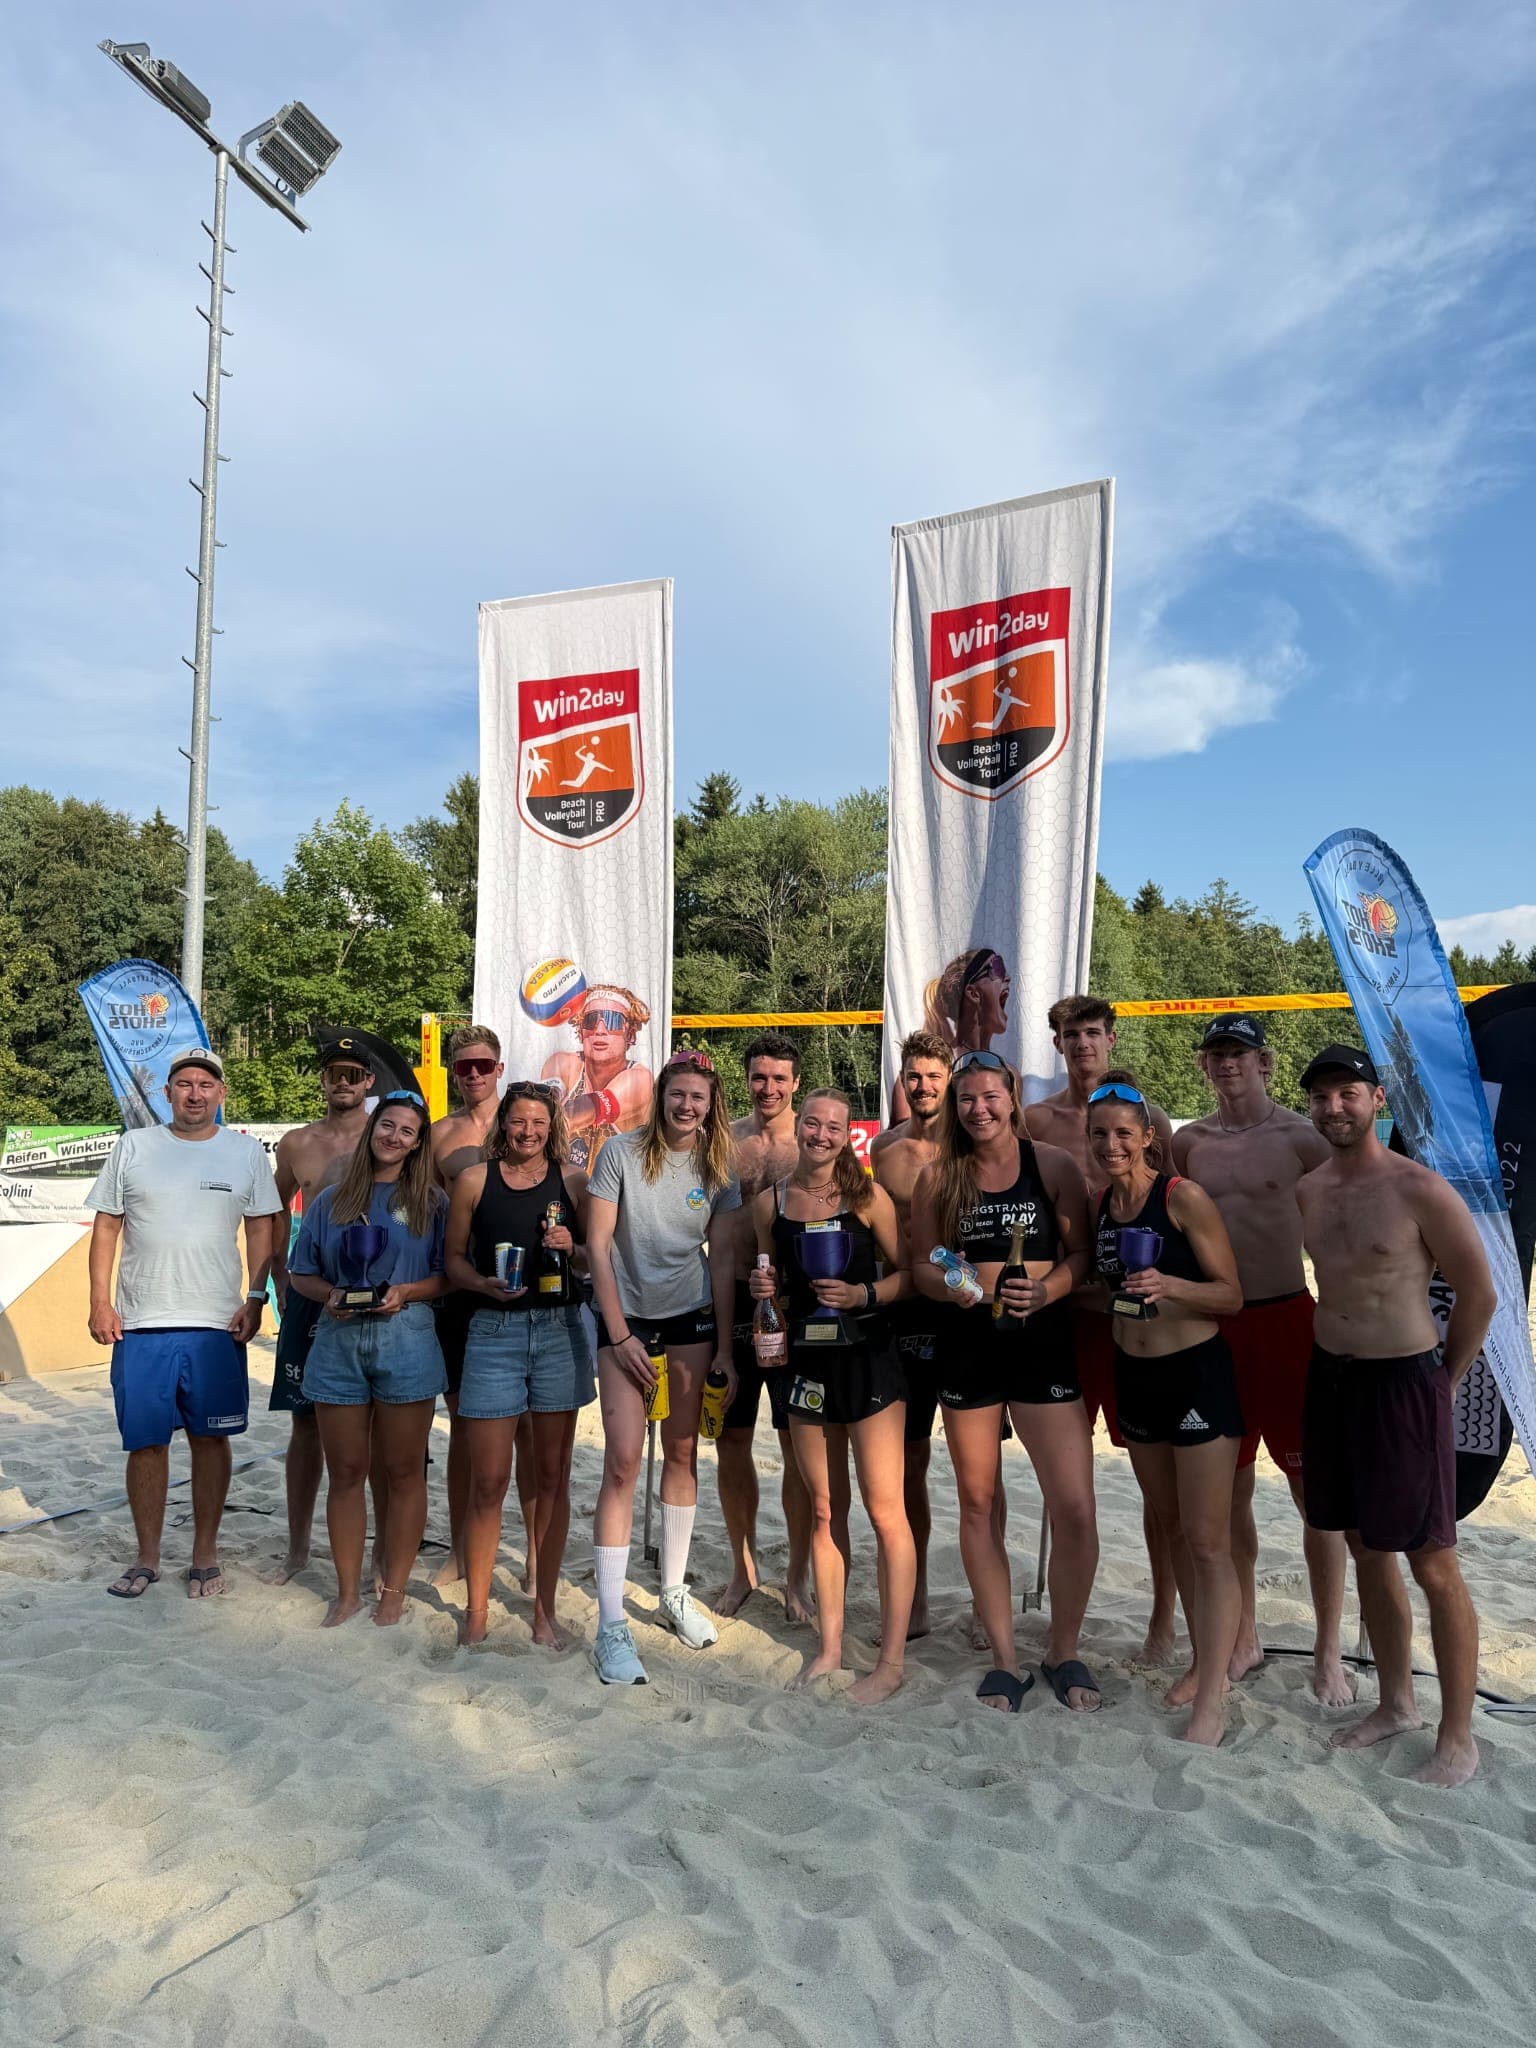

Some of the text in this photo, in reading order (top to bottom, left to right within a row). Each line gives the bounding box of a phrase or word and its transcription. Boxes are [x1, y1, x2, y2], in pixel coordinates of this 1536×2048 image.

[948, 610, 1050, 659] win2day
[533, 687, 625, 724] win2day
[972, 741, 1001, 755] Beach
[1009, 741, 1019, 767] PRO
[956, 753, 1001, 771] Volleyball
[979, 767, 1001, 779] Tour
[560, 797, 586, 810] Beach
[544, 806, 586, 821] Volleyball
[595, 800, 605, 823] PRO
[567, 820, 586, 830] Tour
[339, 1038, 353, 1050] C
[60, 1140, 115, 1157] Winkler
[6, 1151, 47, 1165] Reifen
[1500, 1142, 1521, 1209] 022
[1179, 1422, 1209, 1430] adidas
